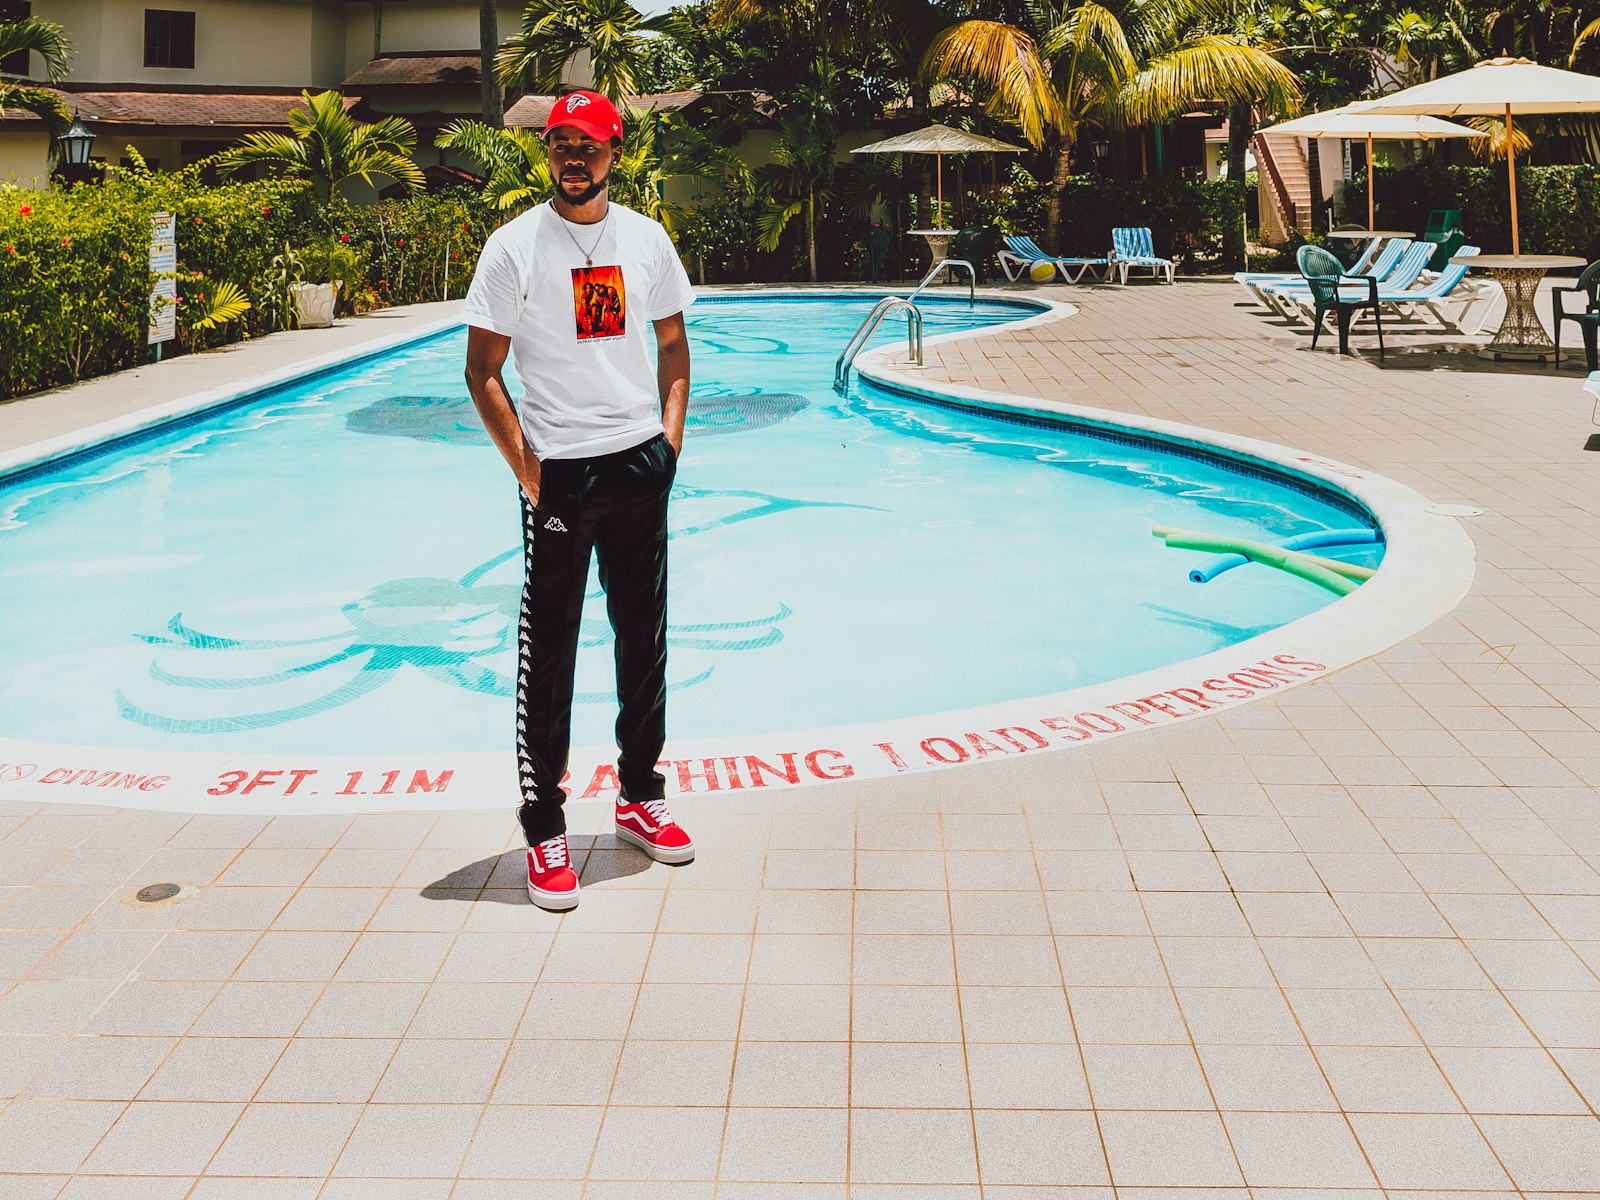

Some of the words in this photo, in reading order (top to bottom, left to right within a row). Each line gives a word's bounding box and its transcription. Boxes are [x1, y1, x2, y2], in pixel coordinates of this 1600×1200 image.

[519, 749, 856, 803] AHING
[1038, 710, 1125, 741] 50
[1105, 654, 1327, 726] PERSONS
[38, 767, 172, 792] DIVING
[206, 769, 319, 797] 3FT.
